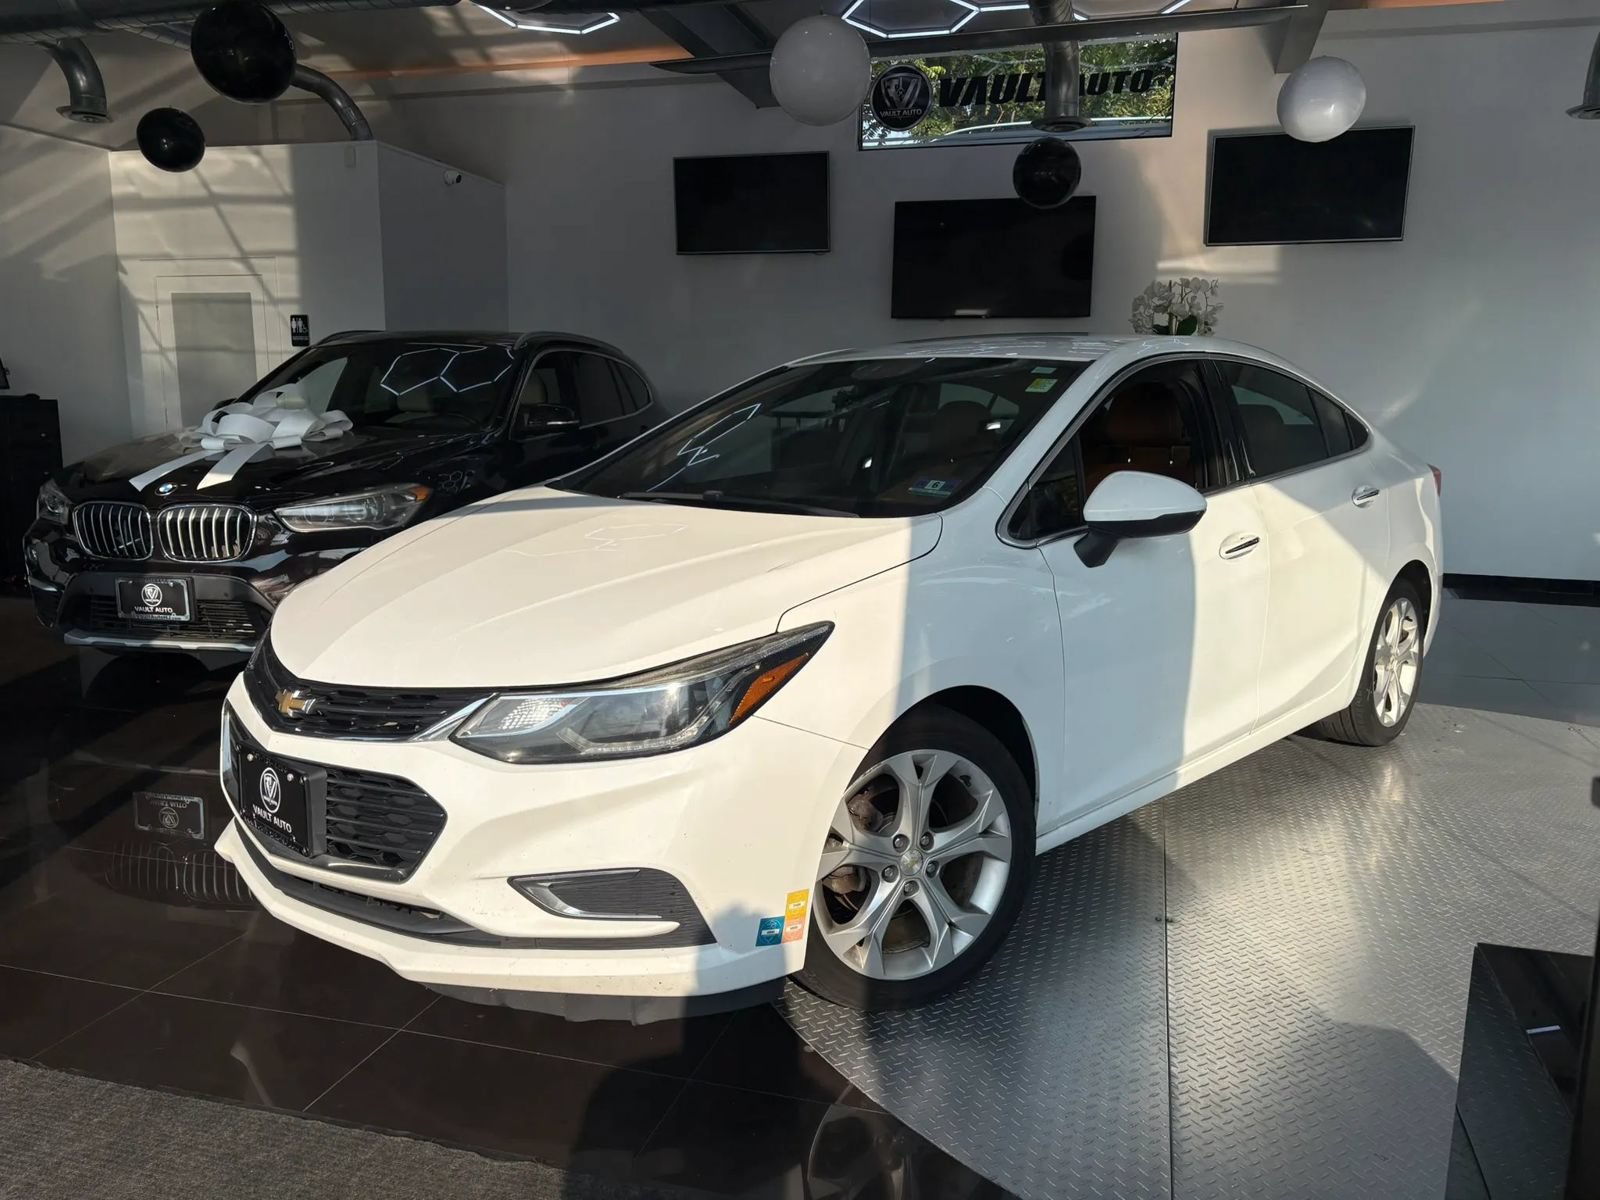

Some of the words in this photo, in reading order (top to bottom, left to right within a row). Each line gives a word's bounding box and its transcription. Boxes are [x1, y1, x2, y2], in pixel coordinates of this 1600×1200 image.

[1079, 70, 1152, 95] UTO
[880, 110, 901, 118] VAULT
[902, 108, 922, 116] AUTO
[252, 803, 272, 822] VAULT
[273, 816, 292, 833] AUTO
